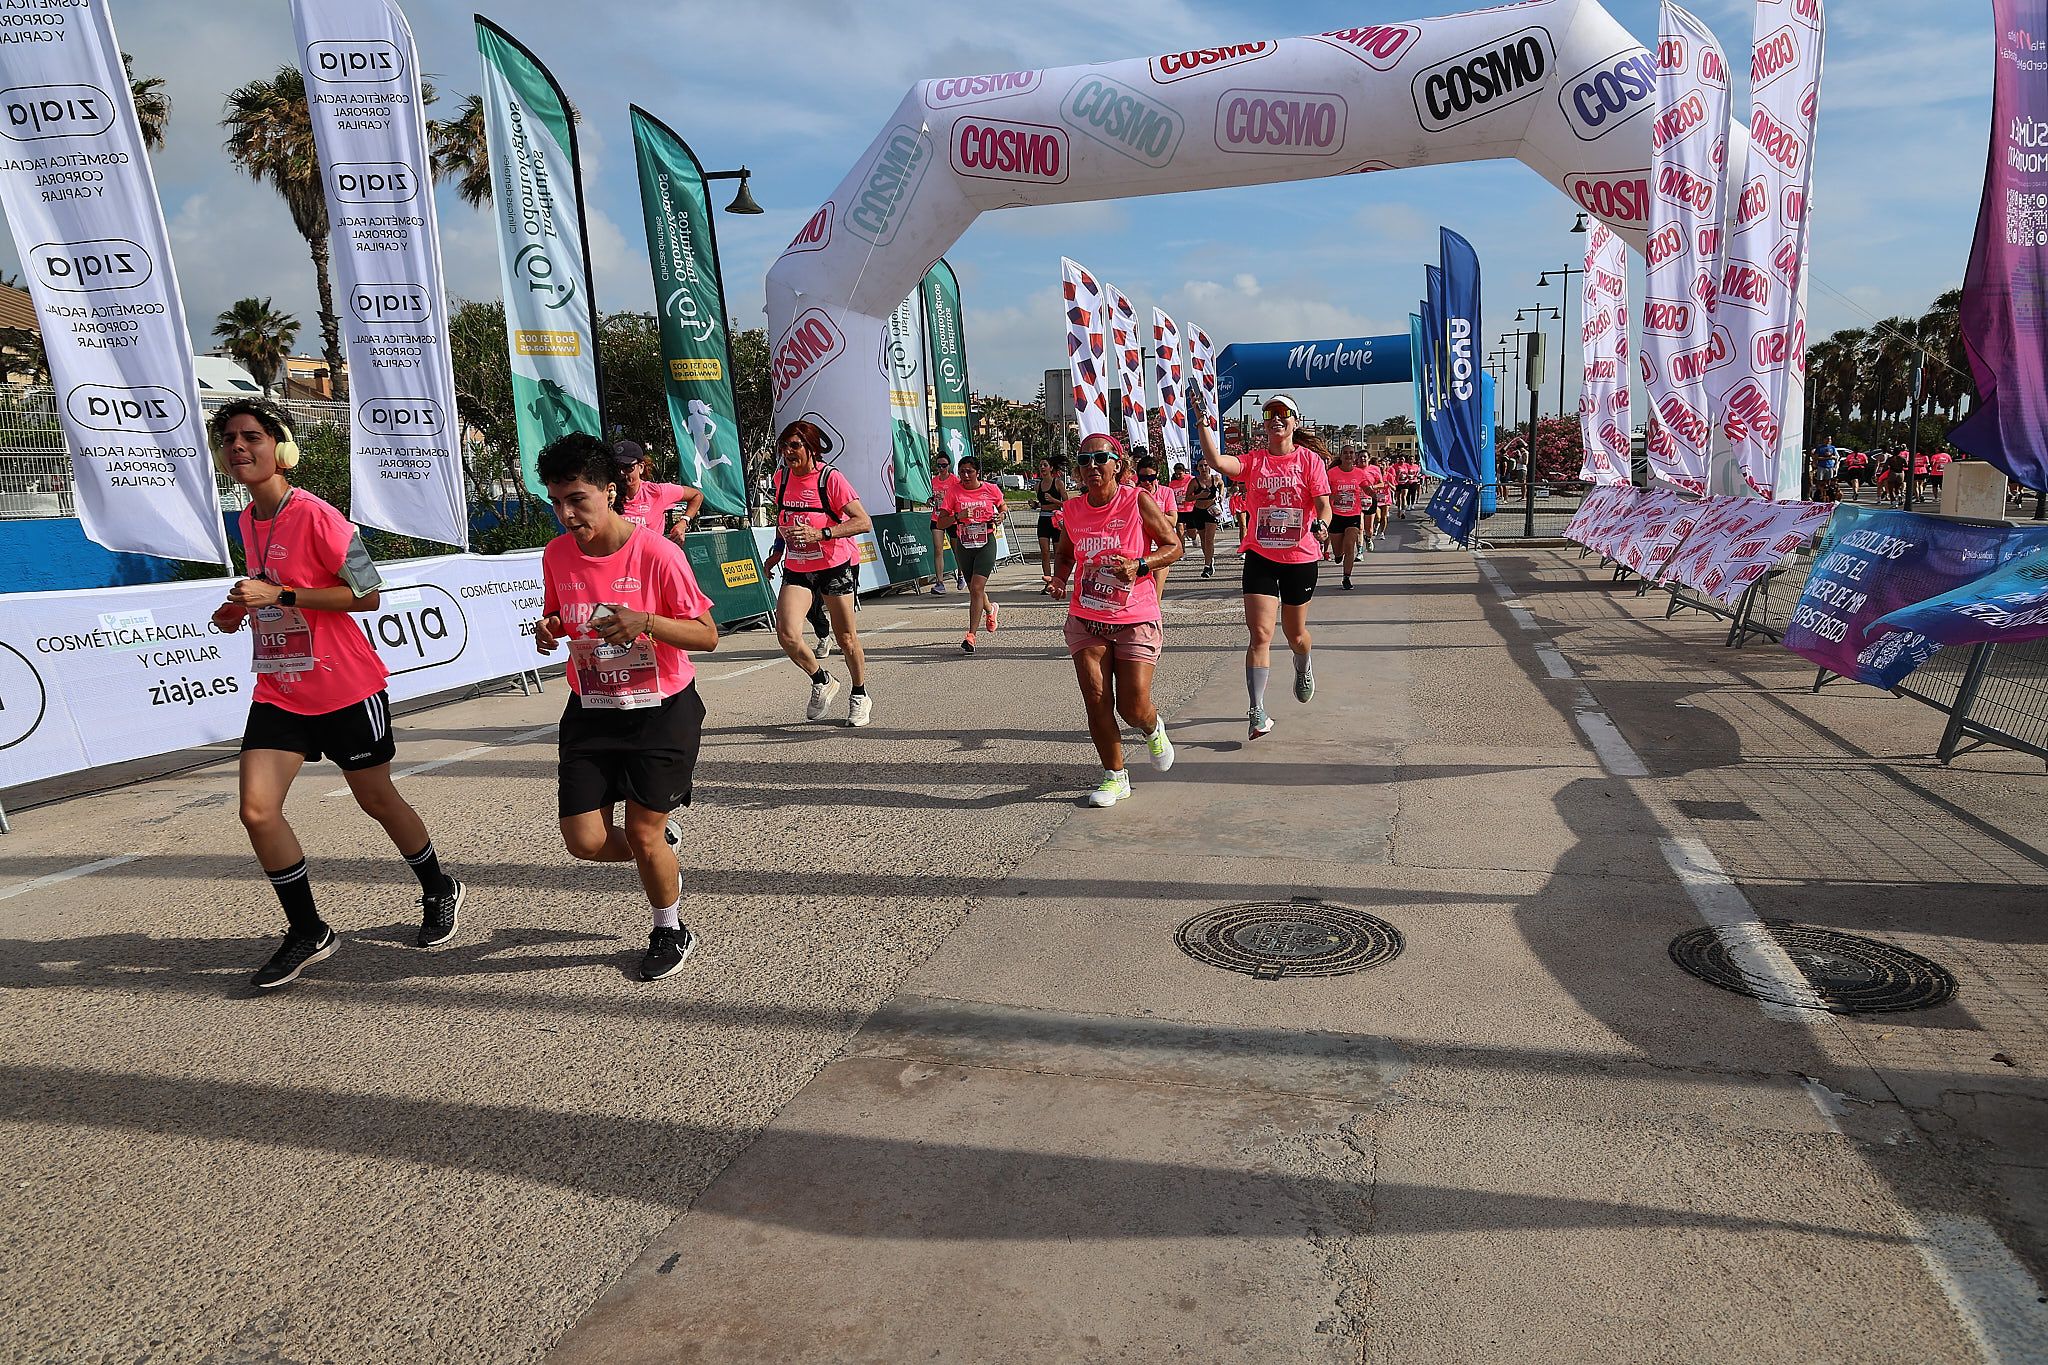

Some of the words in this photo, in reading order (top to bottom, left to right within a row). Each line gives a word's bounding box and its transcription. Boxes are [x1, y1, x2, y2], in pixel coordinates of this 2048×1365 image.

[935, 71, 1034, 101] COSMO
[1424, 36, 1545, 121] COSMO
[1573, 53, 1657, 127] COSM
[1072, 81, 1173, 158] COSMO
[1226, 97, 1337, 148] COSMO
[960, 125, 1060, 177] COSMO
[852, 135, 923, 234] COSMO
[1575, 180, 1649, 221] COSM
[1287, 343, 1373, 381] Marlene
[1257, 476, 1298, 489] CARRERA
[724, 567, 736, 575] 900
[460, 581, 513, 599] COSMÉTICA
[514, 579, 543, 592] FACIAL,
[1094, 582, 1114, 594] 016
[511, 600, 520, 610] Y
[519, 597, 545, 610] CAPILA
[36, 627, 145, 654] COSMÉTICA
[145, 623, 206, 642] FACIAL,
[261, 633, 287, 646] 016
[362, 607, 448, 658] iaja
[137, 654, 149, 669] Y
[153, 645, 222, 667] CAPILAR
[148, 676, 239, 706] ziaja.es
[600, 669, 631, 684] 016
